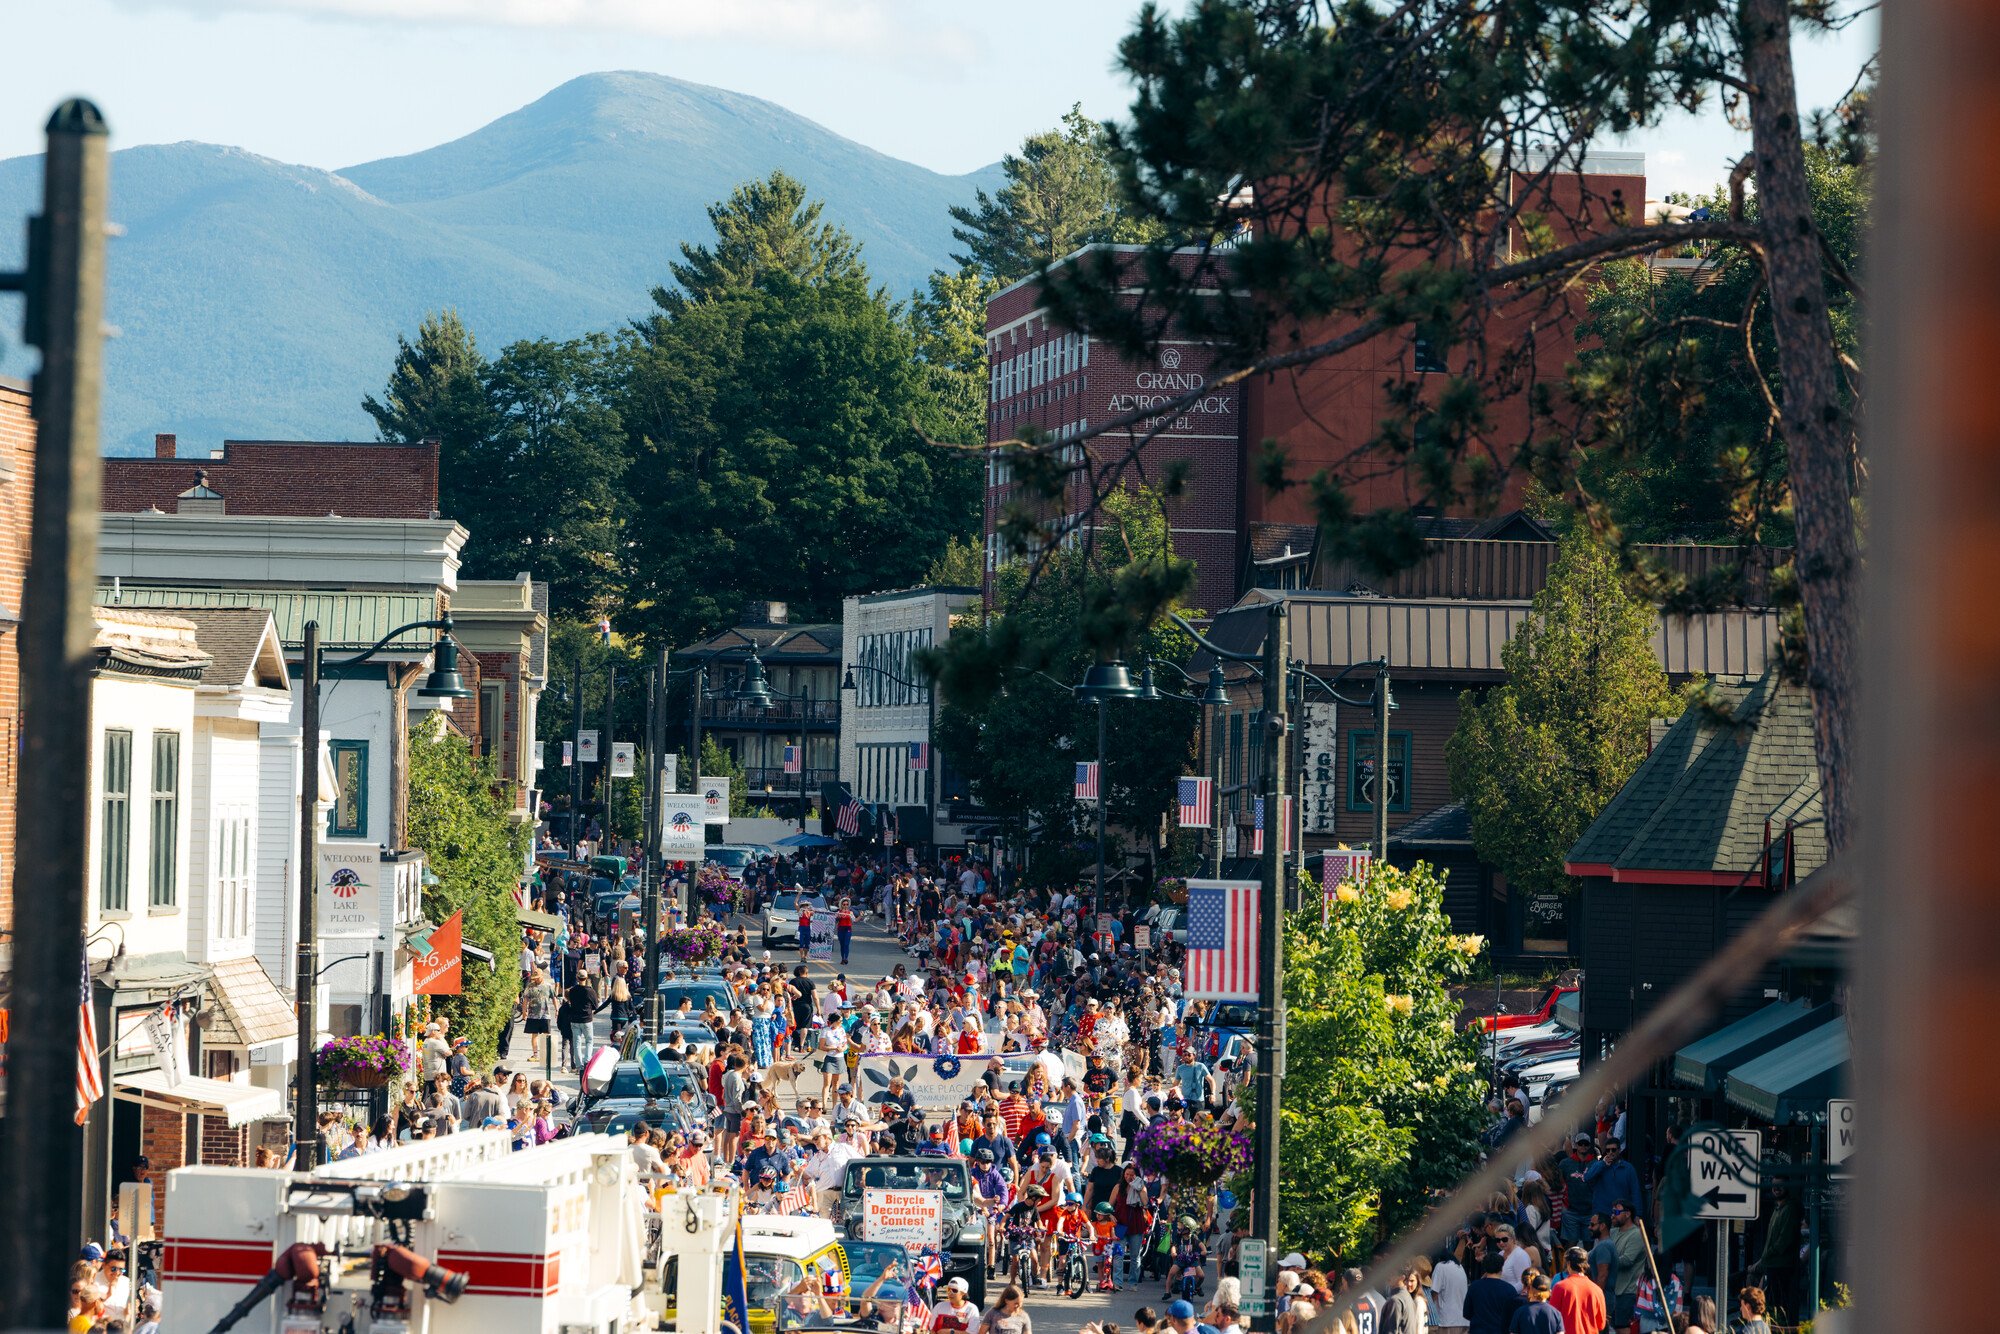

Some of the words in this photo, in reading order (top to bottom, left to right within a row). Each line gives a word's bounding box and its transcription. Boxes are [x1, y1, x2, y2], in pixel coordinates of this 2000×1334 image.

[1136, 372, 1204, 390] GRAND
[1107, 394, 1231, 414] ADIROACK
[1317, 752, 1331, 828] GRILL
[324, 854, 373, 863] WELCOME
[333, 901, 358, 910] LAKE
[1530, 901, 1563, 913] BURGER
[330, 914, 365, 922] PLACID
[414, 955, 461, 991] Sandwiches
[148, 1024, 166, 1053] SHOW
[912, 1085, 933, 1094] LAKE
[938, 1084, 973, 1094] PLACID
[1701, 1161, 1746, 1180] WAY
[885, 1194, 925, 1206] Bicycle
[871, 1205, 935, 1218] Decorating
[881, 1215, 925, 1226] Contest
[880, 1227, 914, 1235] Sponsored
